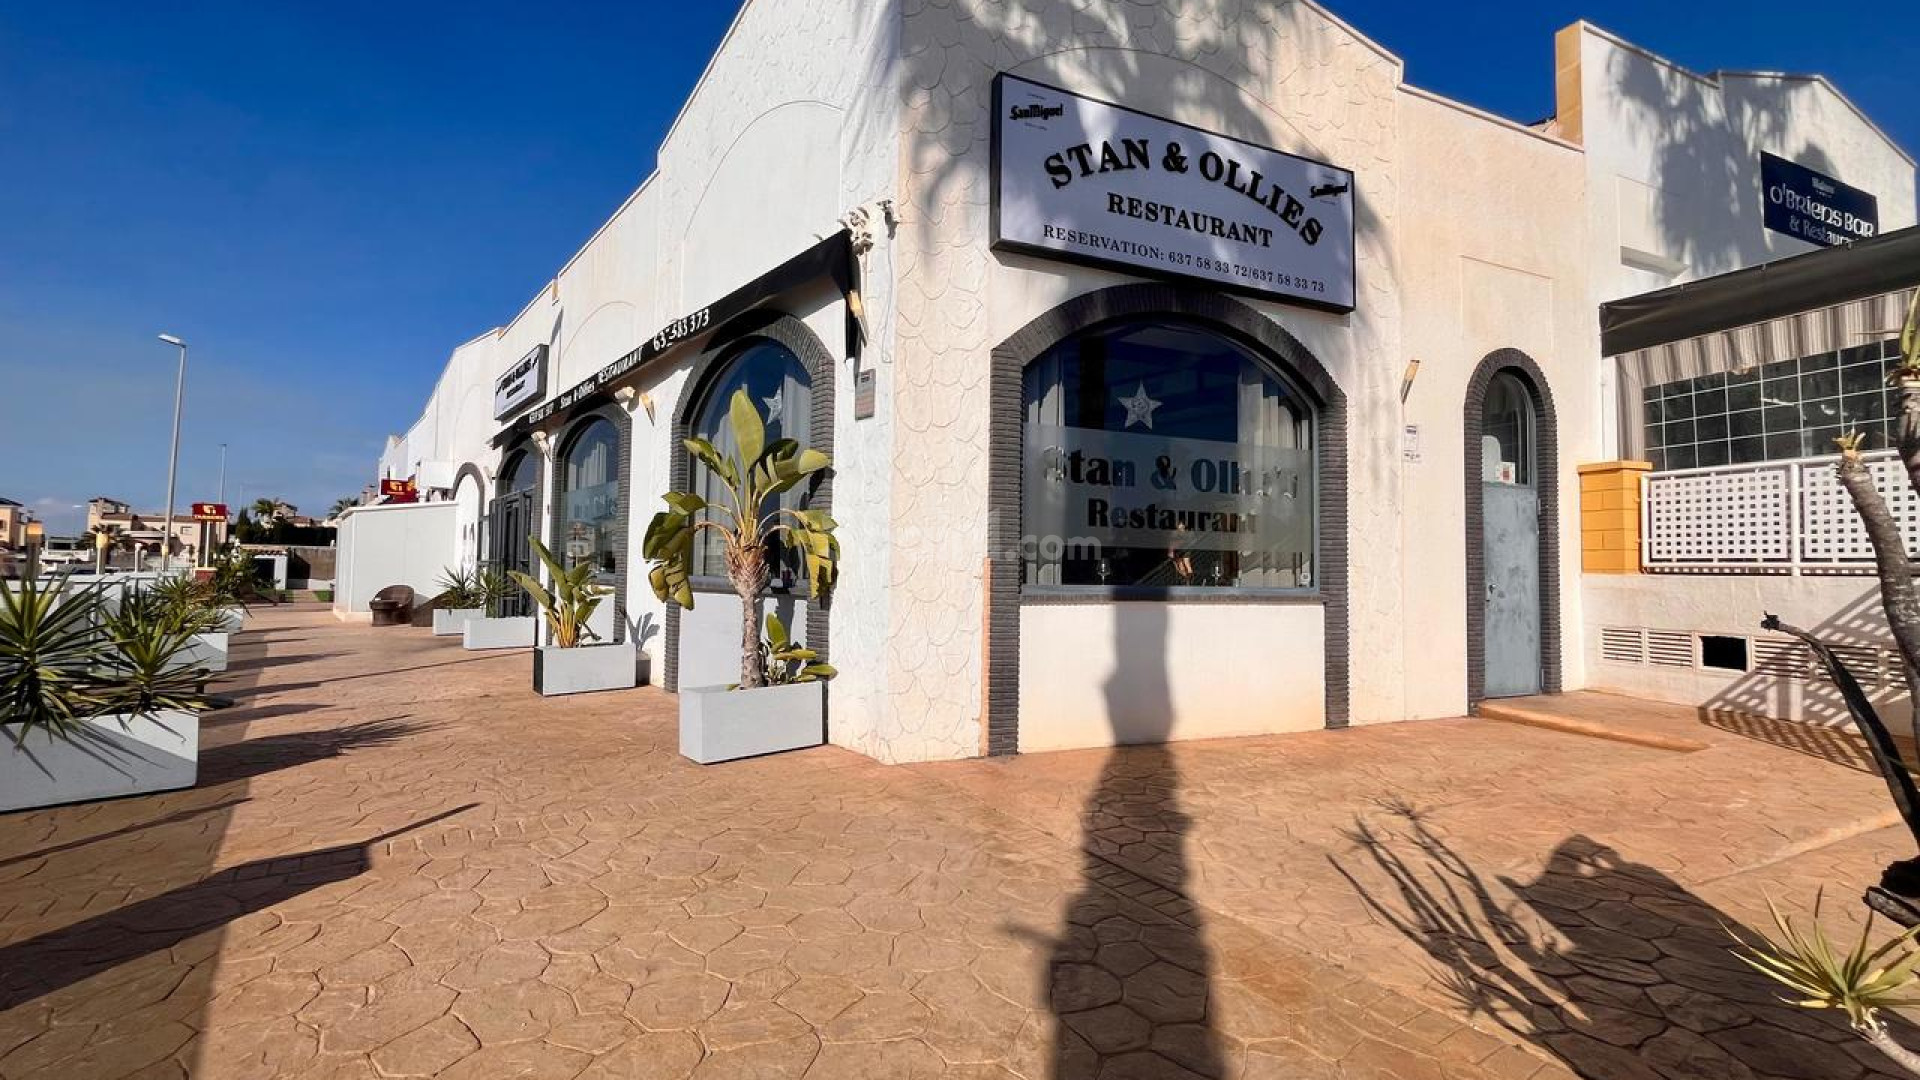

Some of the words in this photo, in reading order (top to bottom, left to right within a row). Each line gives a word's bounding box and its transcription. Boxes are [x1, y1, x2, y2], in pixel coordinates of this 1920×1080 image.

[1044, 139, 1150, 189] STAN
[1162, 142, 1188, 173] &
[1107, 191, 1273, 248] RESTAURANT
[1043, 224, 1165, 260] RESERVATION:
[1168, 251, 1192, 266] 637
[1196, 256, 1212, 271] 58
[1214, 260, 1230, 275] 33
[1277, 271, 1292, 286] 58
[1294, 275, 1309, 290] 33
[1311, 280, 1326, 293] 73
[1043, 446, 1136, 487] Stan
[1151, 456, 1177, 491] &
